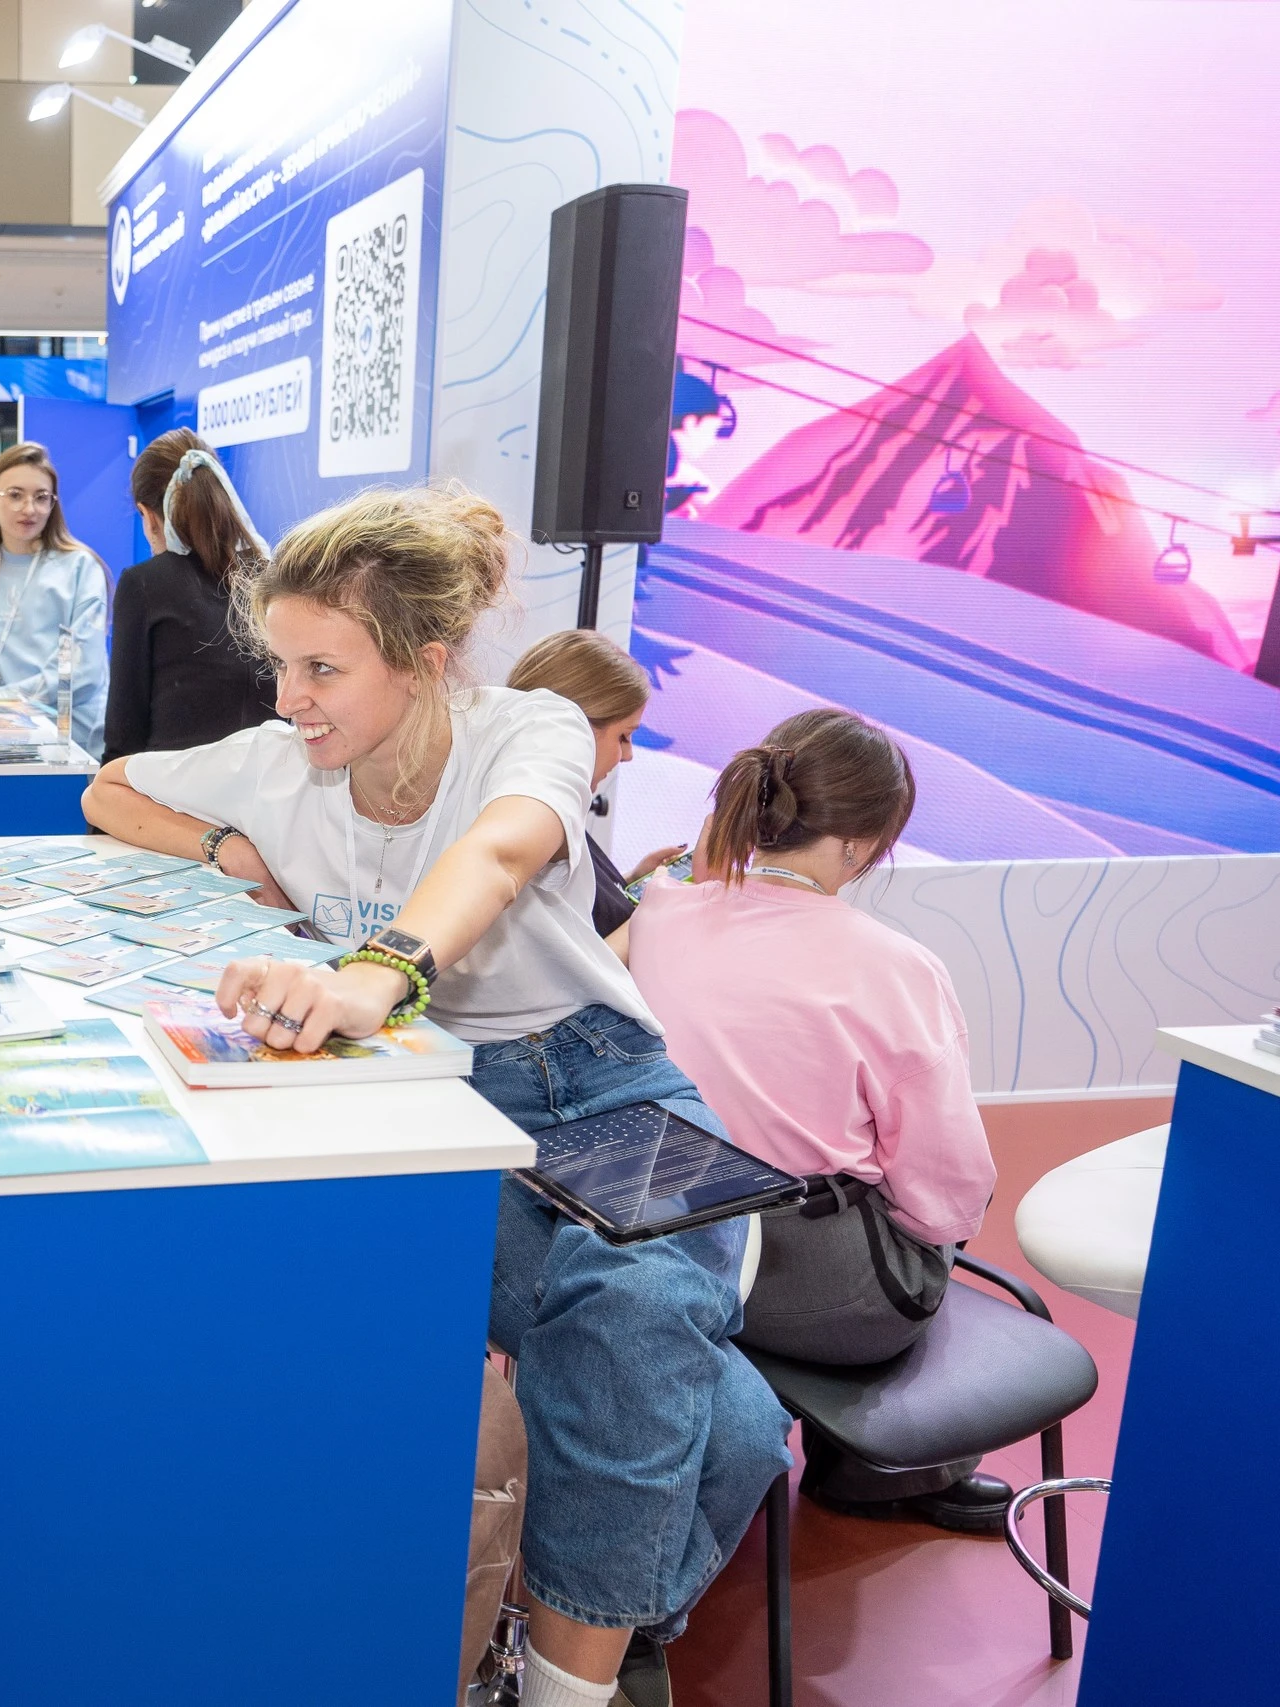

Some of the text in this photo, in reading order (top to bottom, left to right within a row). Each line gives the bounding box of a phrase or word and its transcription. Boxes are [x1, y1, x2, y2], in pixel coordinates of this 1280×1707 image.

[209, 401, 228, 429] 000
[230, 394, 252, 423] 000
[254, 370, 303, 420] РУБЛЕЙ
